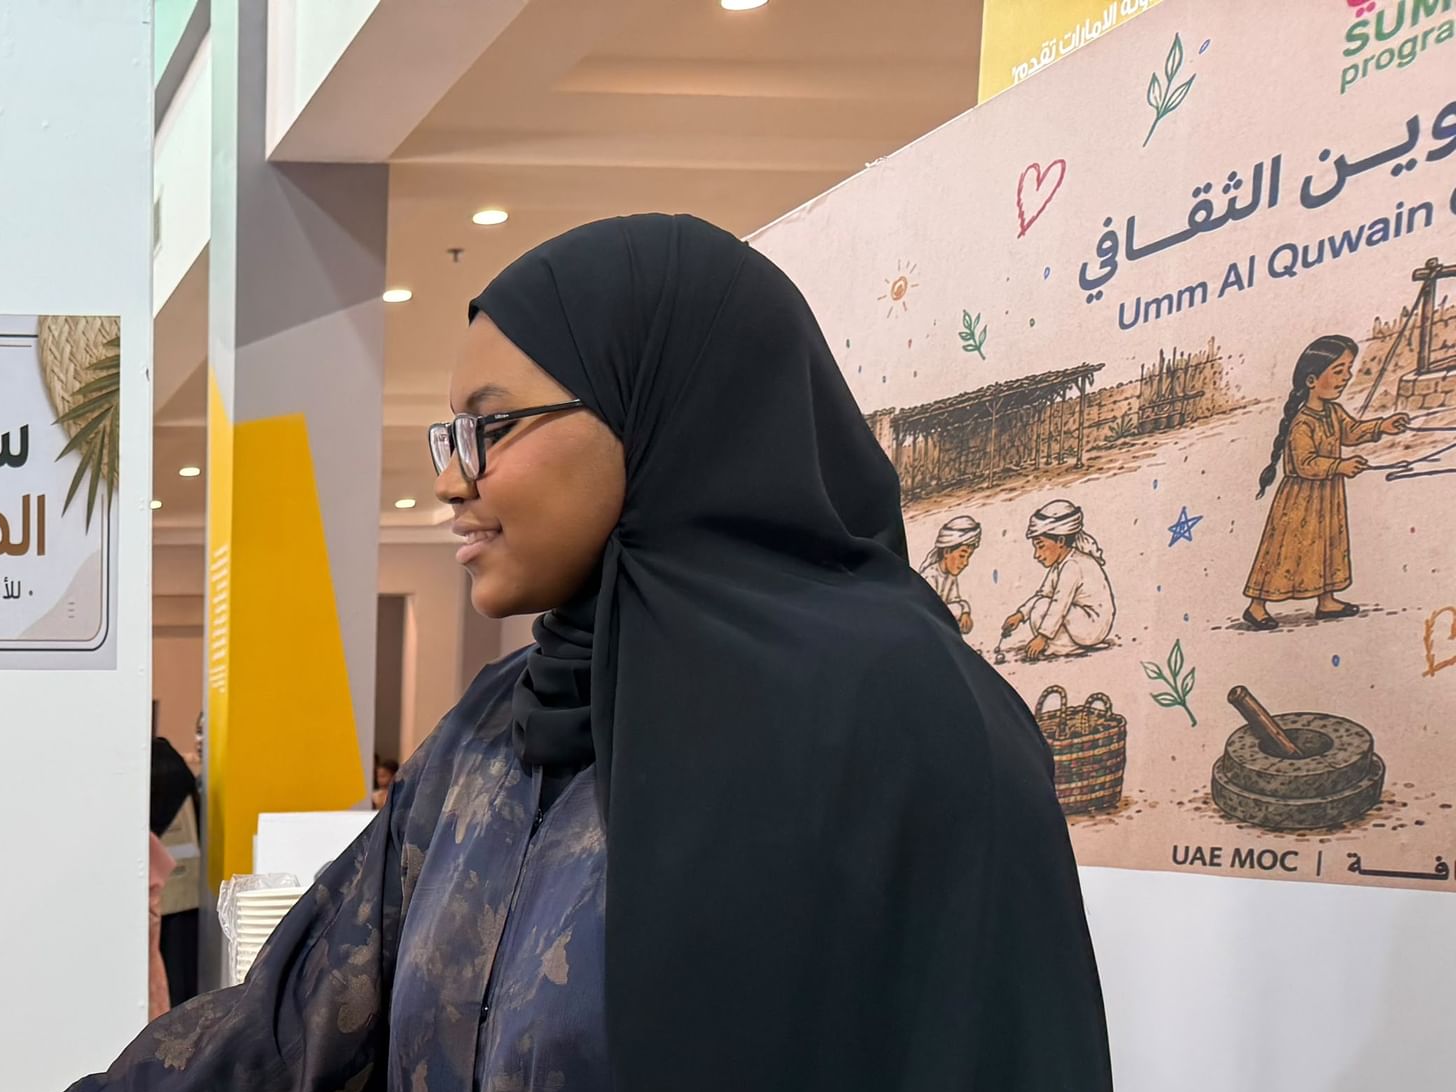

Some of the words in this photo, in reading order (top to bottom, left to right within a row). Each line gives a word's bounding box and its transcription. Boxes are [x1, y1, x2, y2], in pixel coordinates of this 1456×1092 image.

[1078, 153, 1282, 305] الثقافي
[1117, 276, 1209, 331] Umm
[1217, 255, 1256, 299] Al
[1267, 200, 1434, 280] Quwain
[1172, 844, 1223, 868] UAE
[1230, 847, 1300, 872] MOC
